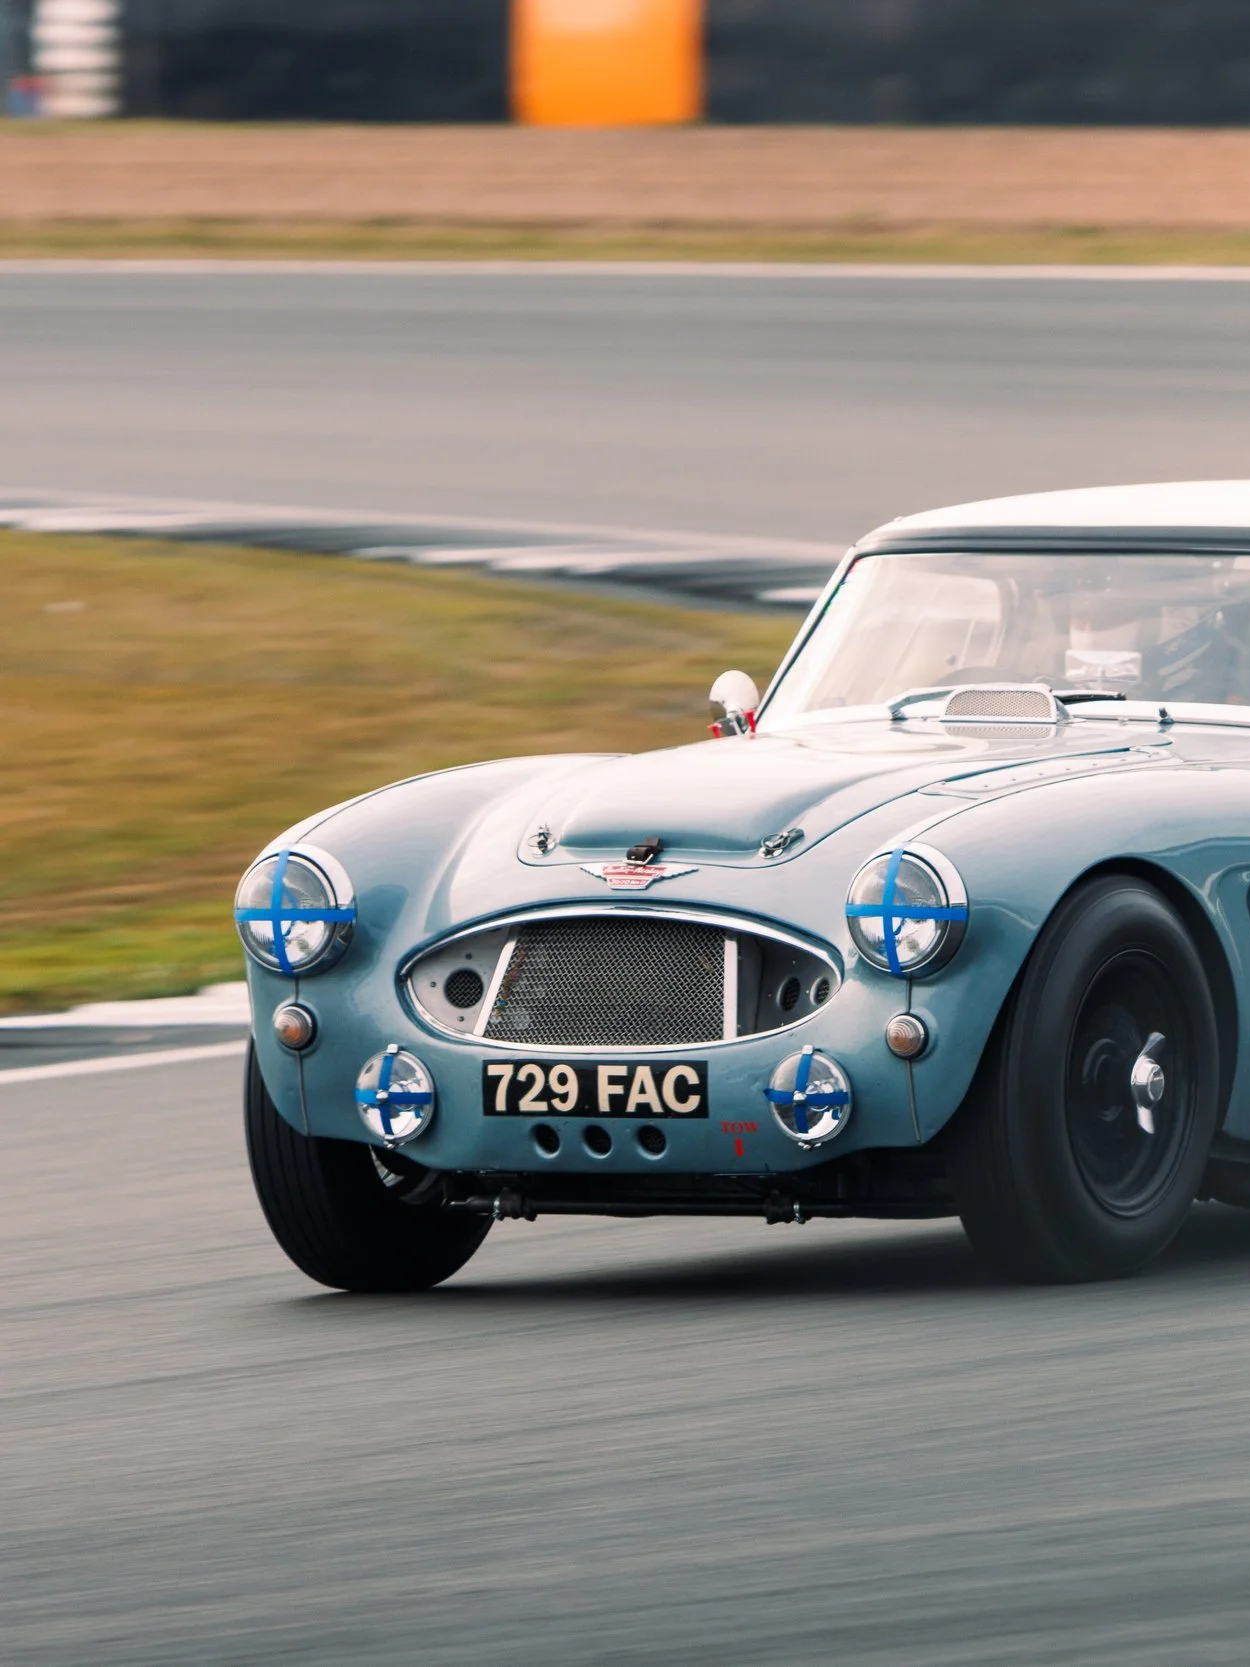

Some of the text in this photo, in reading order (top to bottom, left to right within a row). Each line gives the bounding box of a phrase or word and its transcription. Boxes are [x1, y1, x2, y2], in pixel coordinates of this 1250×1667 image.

[487, 1064, 701, 1113] 729 FAC
[720, 1121, 760, 1134] TOW
